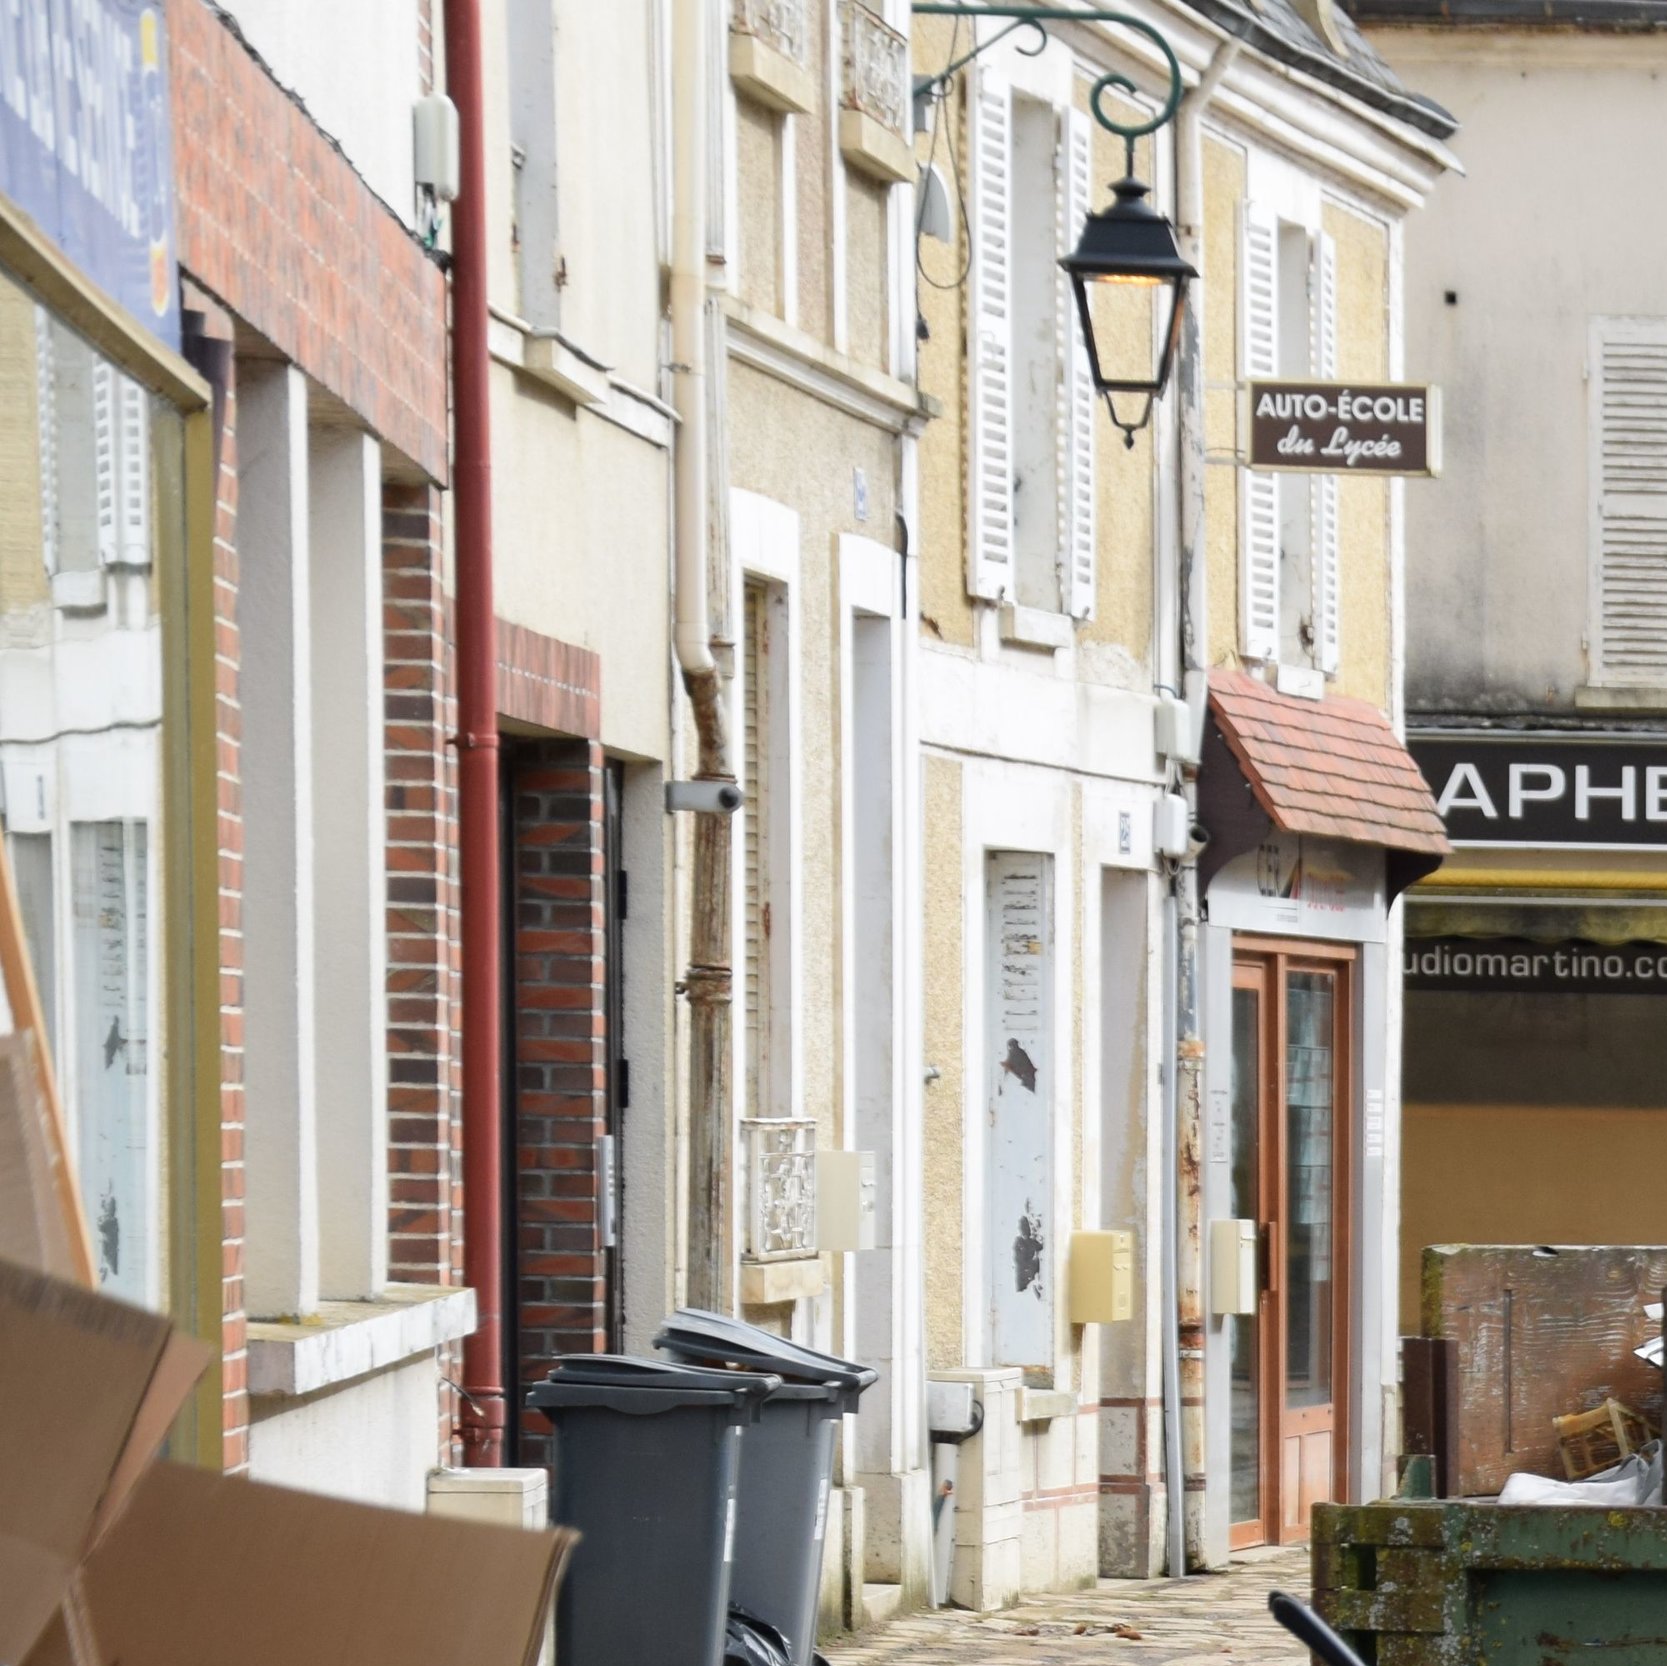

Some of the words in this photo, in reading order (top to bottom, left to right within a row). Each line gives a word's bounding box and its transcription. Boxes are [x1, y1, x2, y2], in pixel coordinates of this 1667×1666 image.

[1256, 389, 1424, 422] AUTO-ÉCOLE
[1277, 424, 1314, 454] du
[1320, 426, 1402, 465] Lycée
